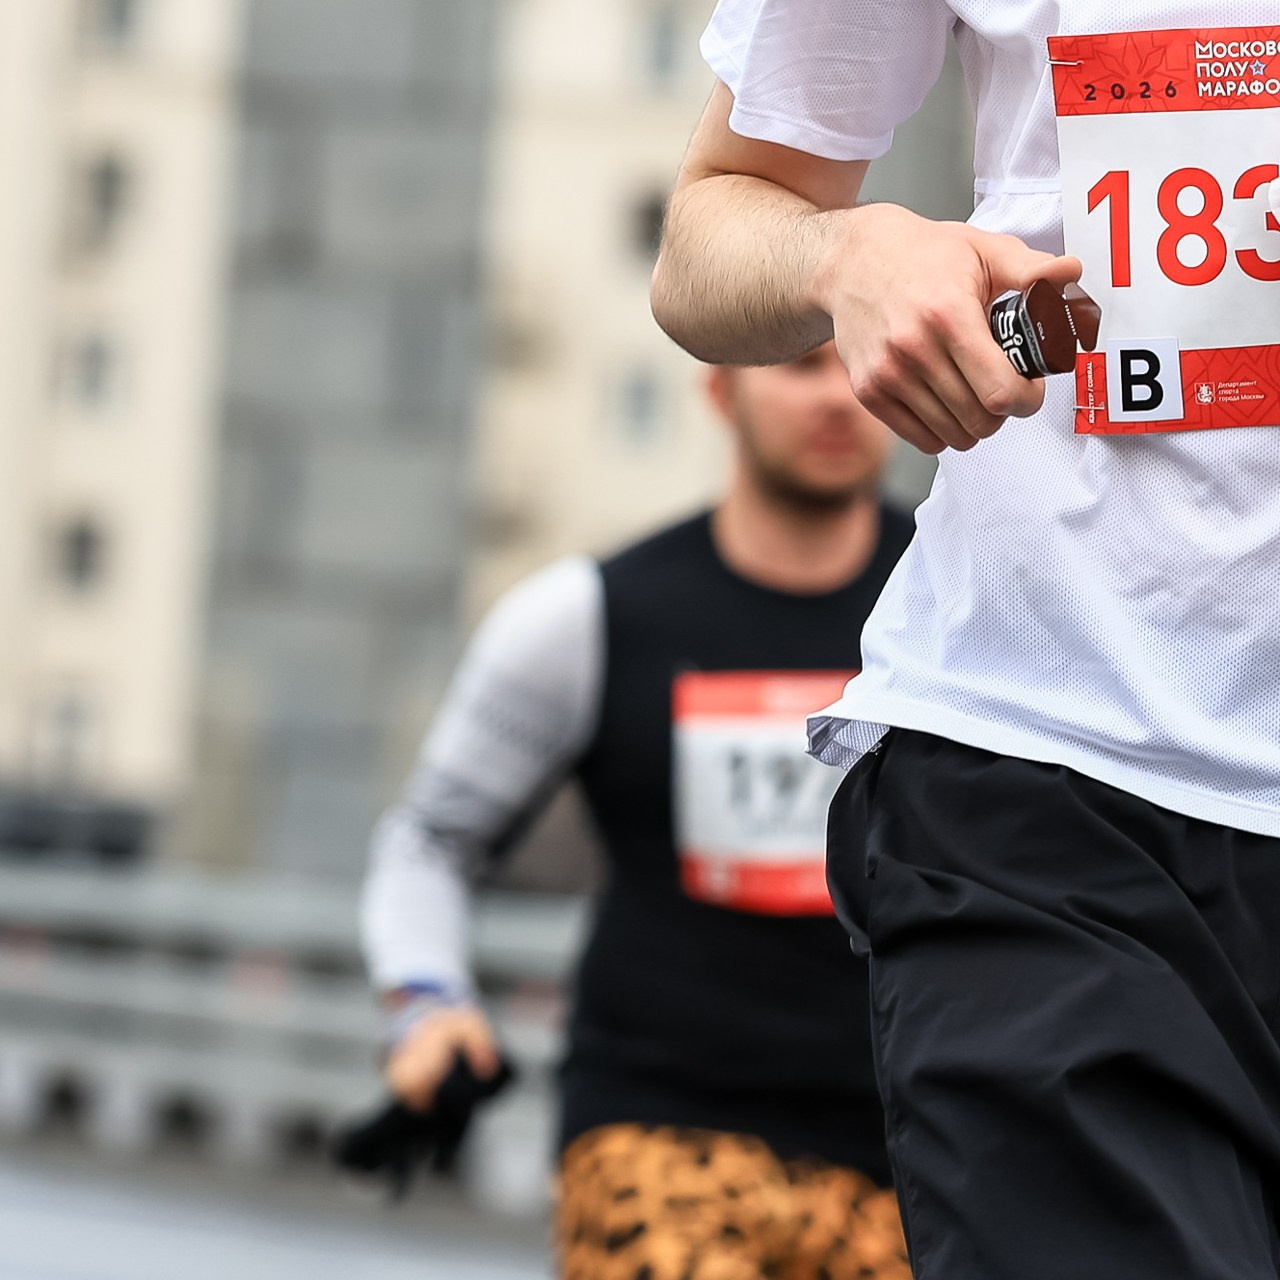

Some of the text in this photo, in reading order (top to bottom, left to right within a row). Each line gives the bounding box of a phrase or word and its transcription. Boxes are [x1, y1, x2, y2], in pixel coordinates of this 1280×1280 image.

[1195, 61, 1249, 78] ПОЛУ
[1084, 81, 1177, 101] 2026
[1036, 321, 1046, 341] COLA
[1086, 361, 1094, 388] CORRAL
